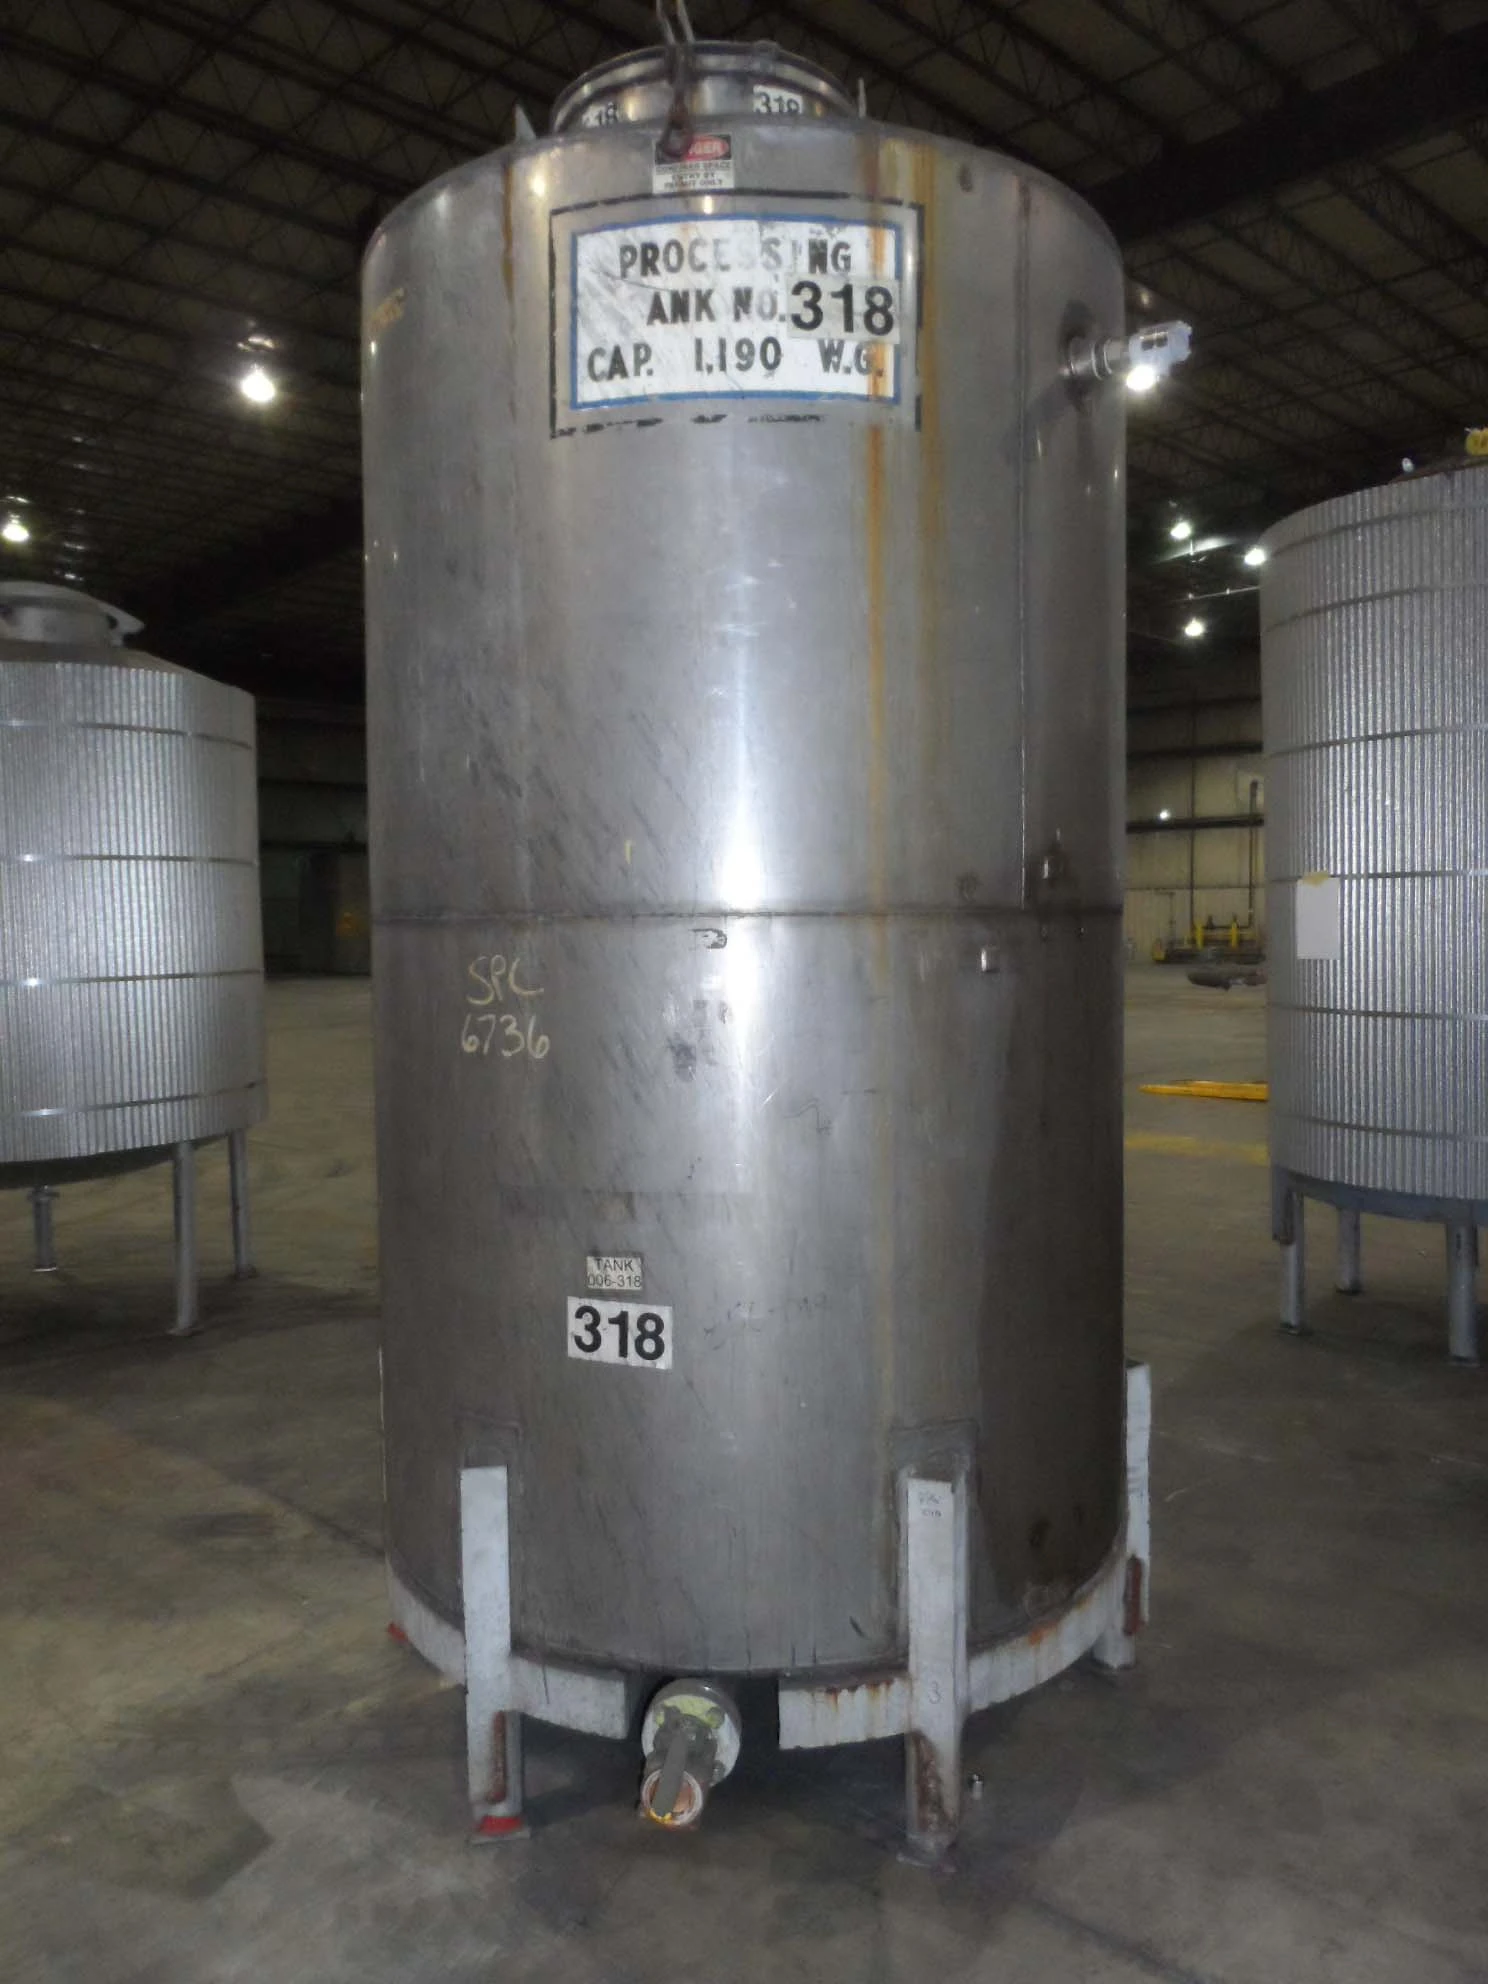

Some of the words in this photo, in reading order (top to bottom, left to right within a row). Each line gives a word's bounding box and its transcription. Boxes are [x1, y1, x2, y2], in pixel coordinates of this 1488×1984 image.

[791, 280, 894, 336] 318
[587, 342, 654, 382] CAP.
[466, 954, 544, 1005] SPC
[461, 1014, 550, 1059] 6736
[588, 1273, 641, 1288] 006-318
[595, 1258, 634, 1272] TANK
[574, 1305, 665, 1361] 318
